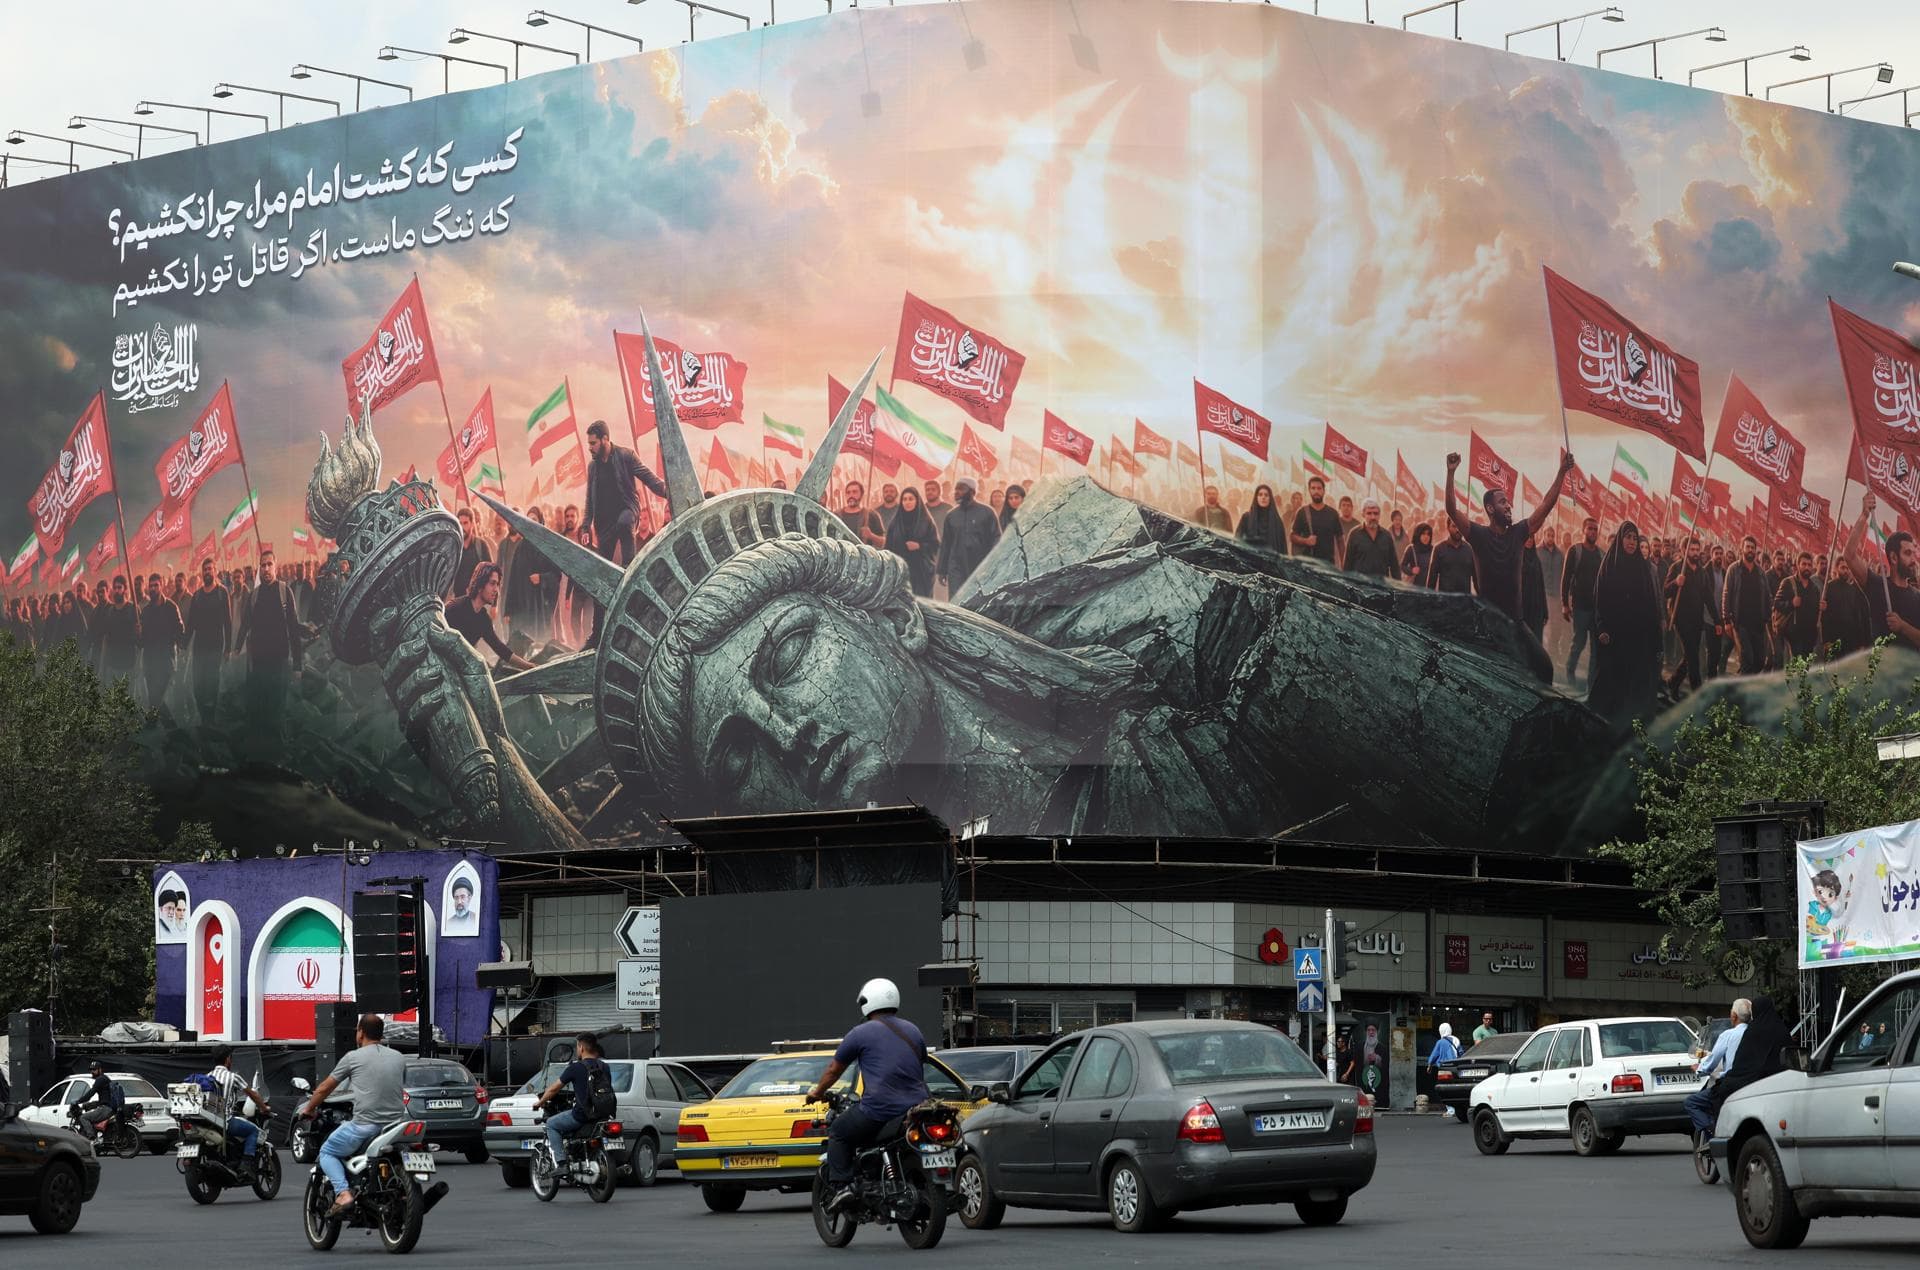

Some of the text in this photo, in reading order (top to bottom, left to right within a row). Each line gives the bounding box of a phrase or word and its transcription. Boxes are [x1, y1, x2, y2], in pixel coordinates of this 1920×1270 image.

[342, 147, 419, 199] کشت
[416, 140, 454, 184] که
[452, 127, 524, 193] کسی
[207, 189, 245, 239] چرا
[289, 162, 340, 230] امام
[480, 194, 515, 233] که
[421, 204, 475, 244] ننگ
[193, 253, 207, 296] را
[209, 254, 234, 294] تو
[237, 237, 289, 288] قاتل
[291, 228, 327, 278] اگر
[112, 257, 190, 318] نکشیم
[643, 912, 660, 920] زاده
[638, 964, 660, 973] شاورز
